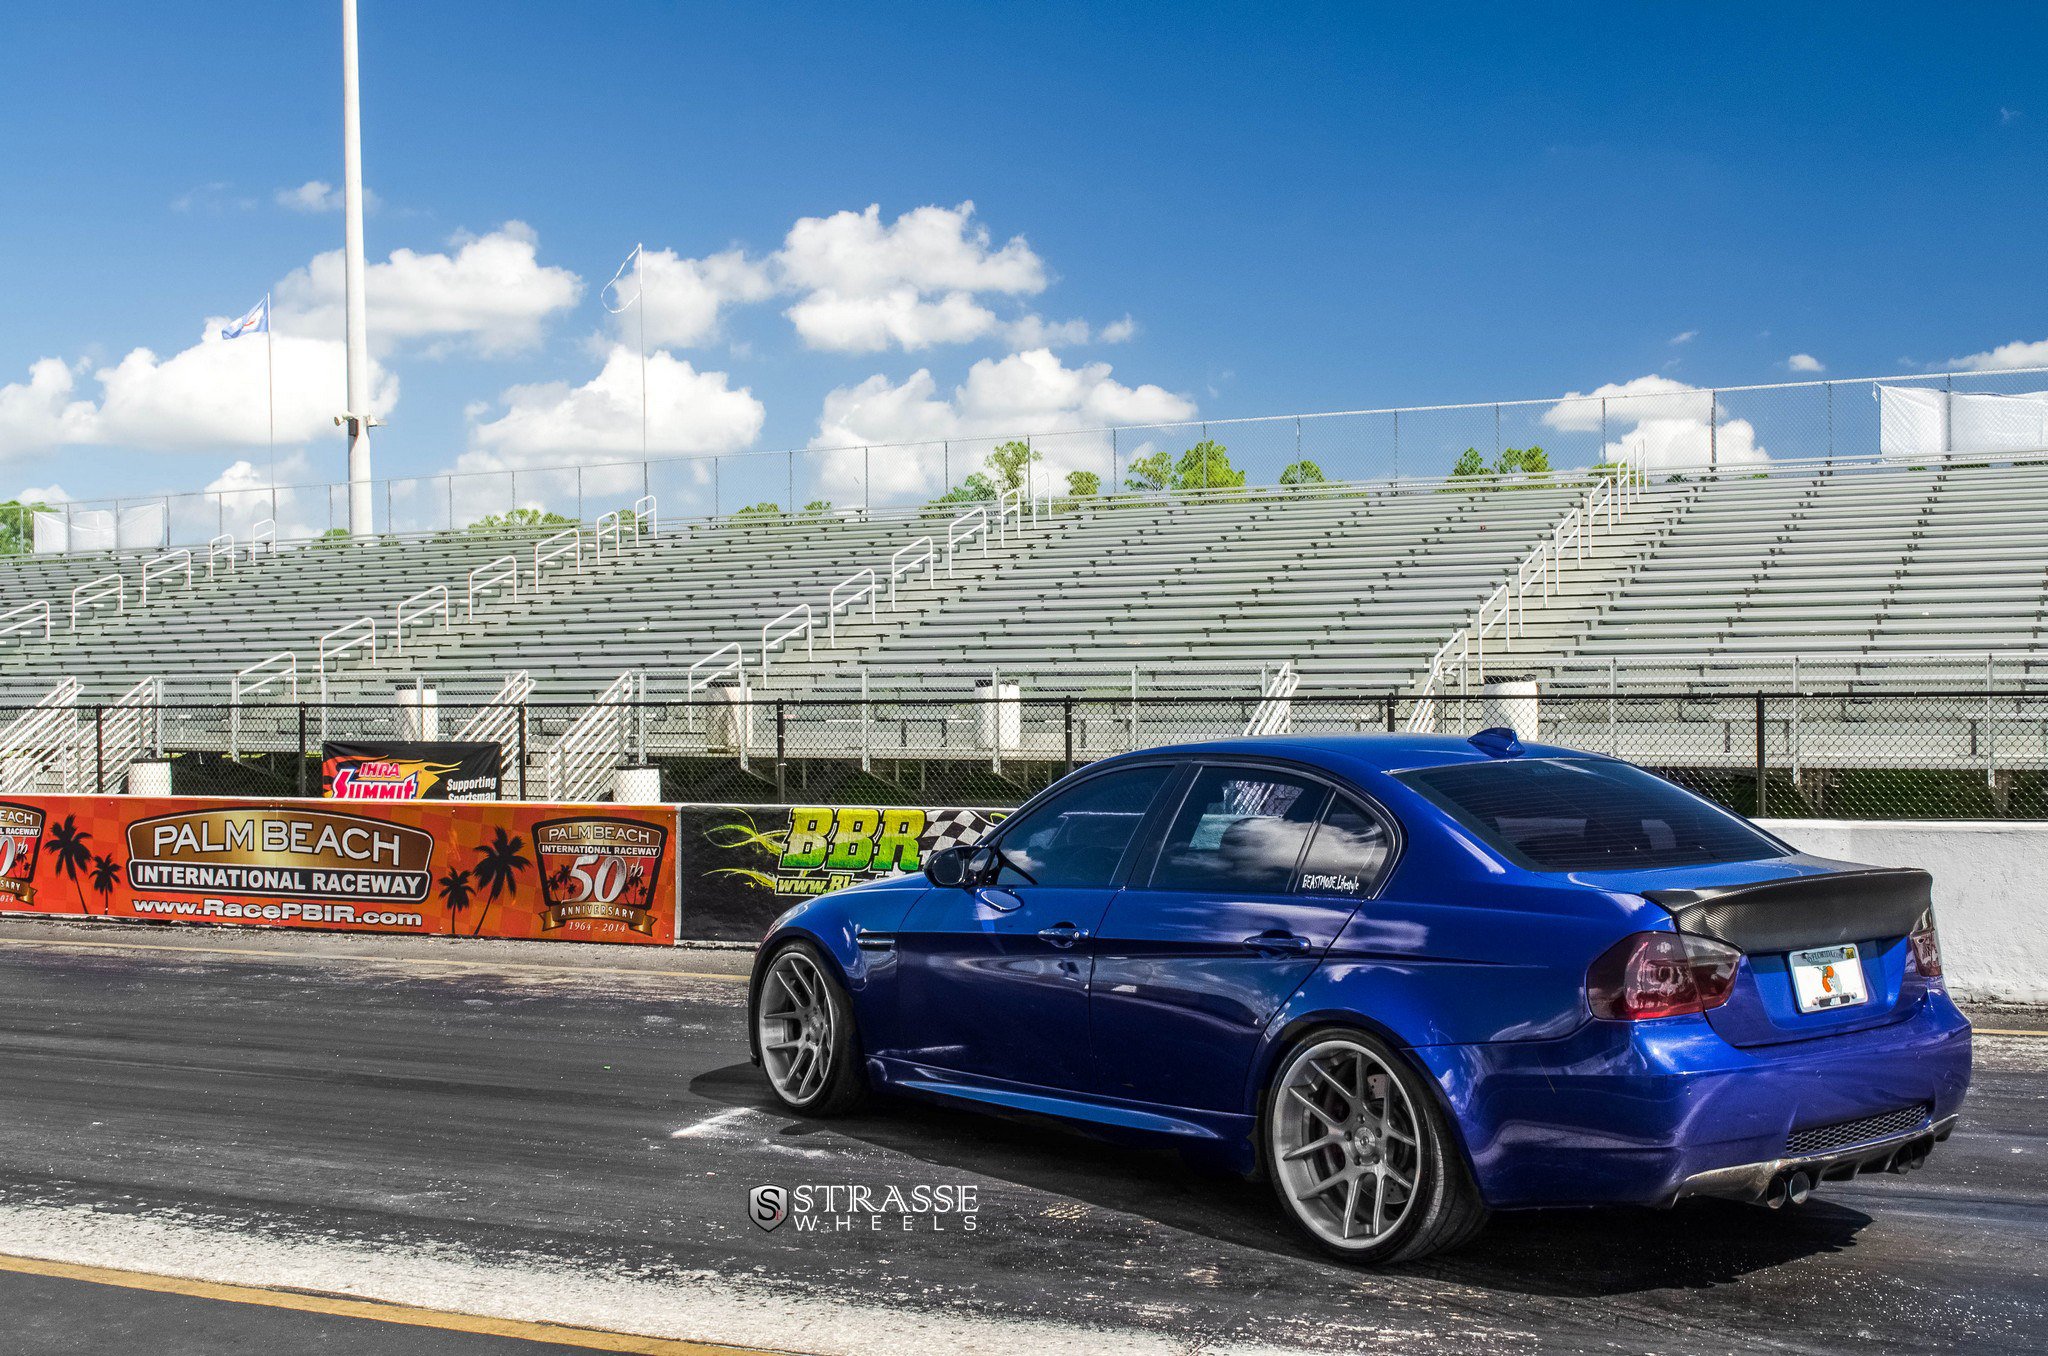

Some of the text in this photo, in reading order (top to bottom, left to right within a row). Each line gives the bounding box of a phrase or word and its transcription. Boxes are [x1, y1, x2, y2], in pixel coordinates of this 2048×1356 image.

[359, 762, 400, 777] IHRA
[446, 776, 497, 793] Supporting
[5, 827, 39, 836] RACEWAY
[548, 825, 650, 844] PALM BEACH
[778, 808, 926, 870] BBR
[153, 819, 401, 866] PALM BEACH
[541, 844, 658, 856] INTERNATIONAL RACEWAY
[137, 865, 422, 895] INTERNATIONAL RACEWAY
[133, 898, 423, 926] www.RacePBIR.com
[560, 905, 635, 919] ANNIVERSARY
[568, 921, 592, 932] 1964
[601, 922, 627, 933] 2014
